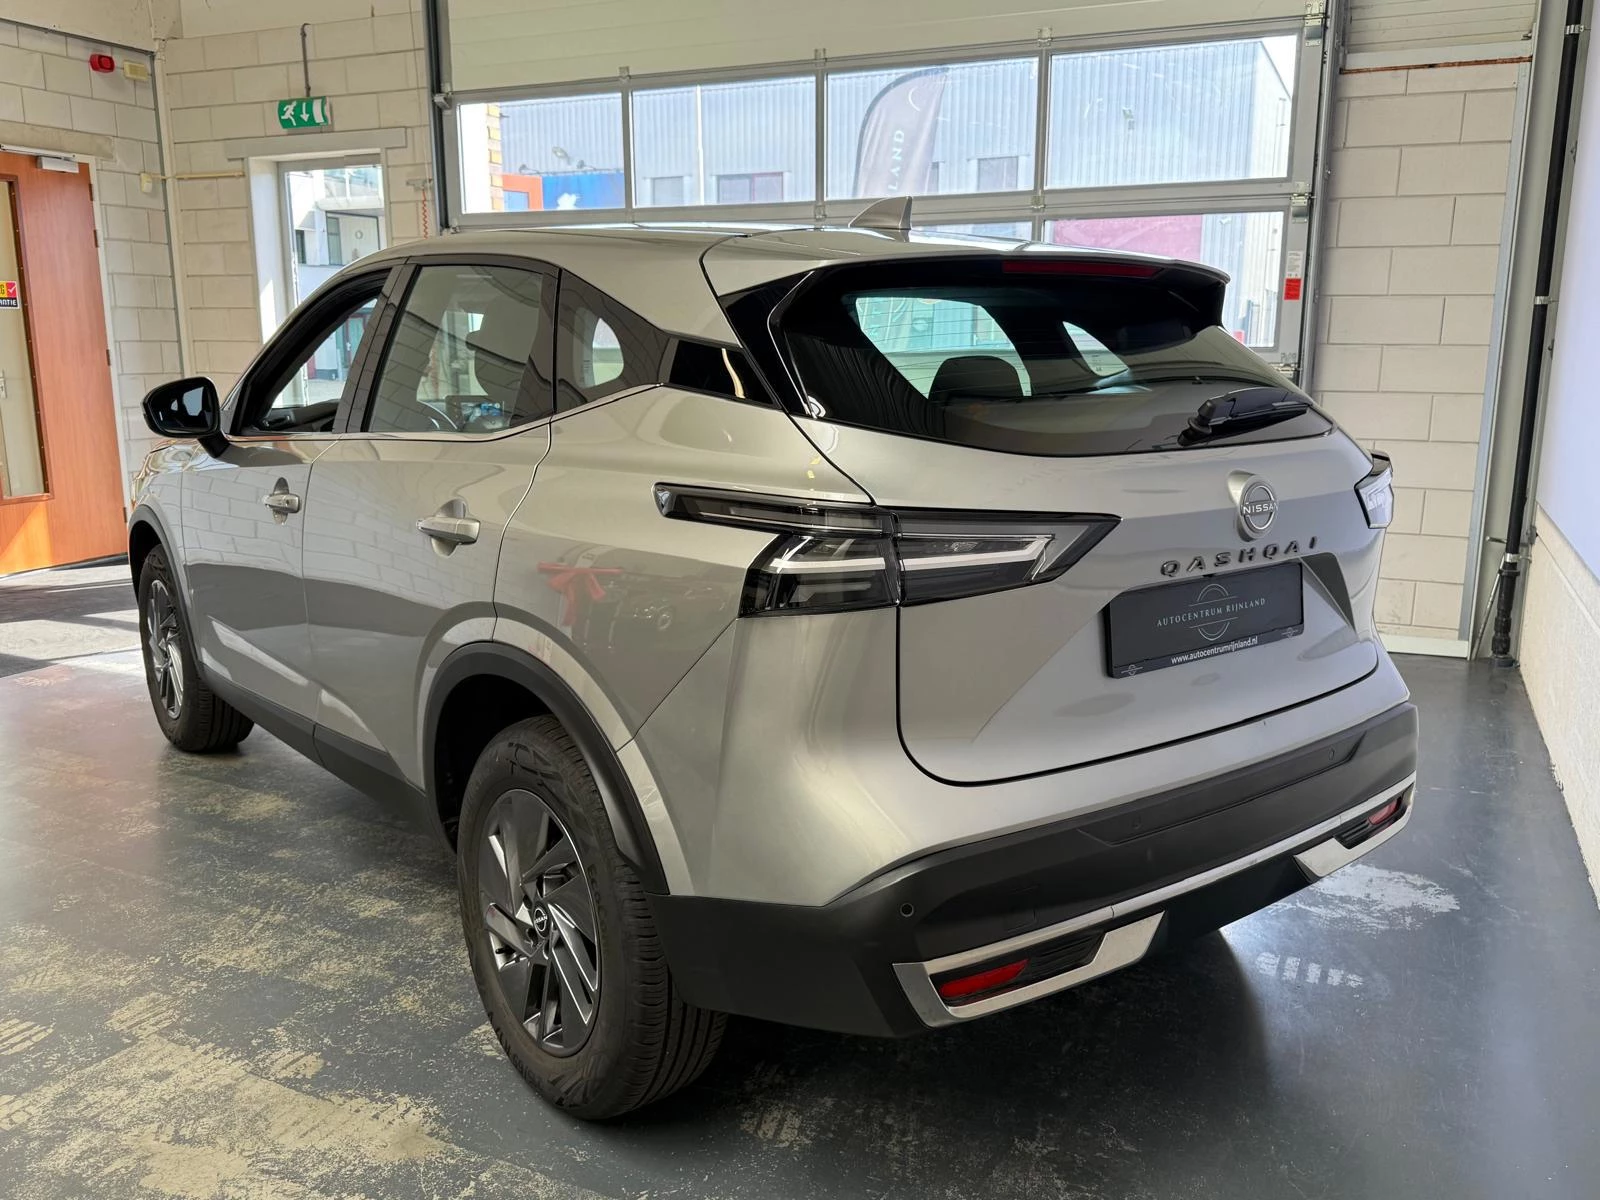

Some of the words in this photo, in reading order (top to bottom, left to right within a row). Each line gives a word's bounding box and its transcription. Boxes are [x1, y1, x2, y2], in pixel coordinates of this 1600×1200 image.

[1243, 502, 1279, 514] NISSAN
[1160, 536, 1317, 577] QASHQAI
[1157, 608, 1223, 627] AUTOCENTRUM
[1226, 598, 1266, 612] RIJNLAND
[1171, 636, 1258, 664] www.autocentrumrijnland.nl
